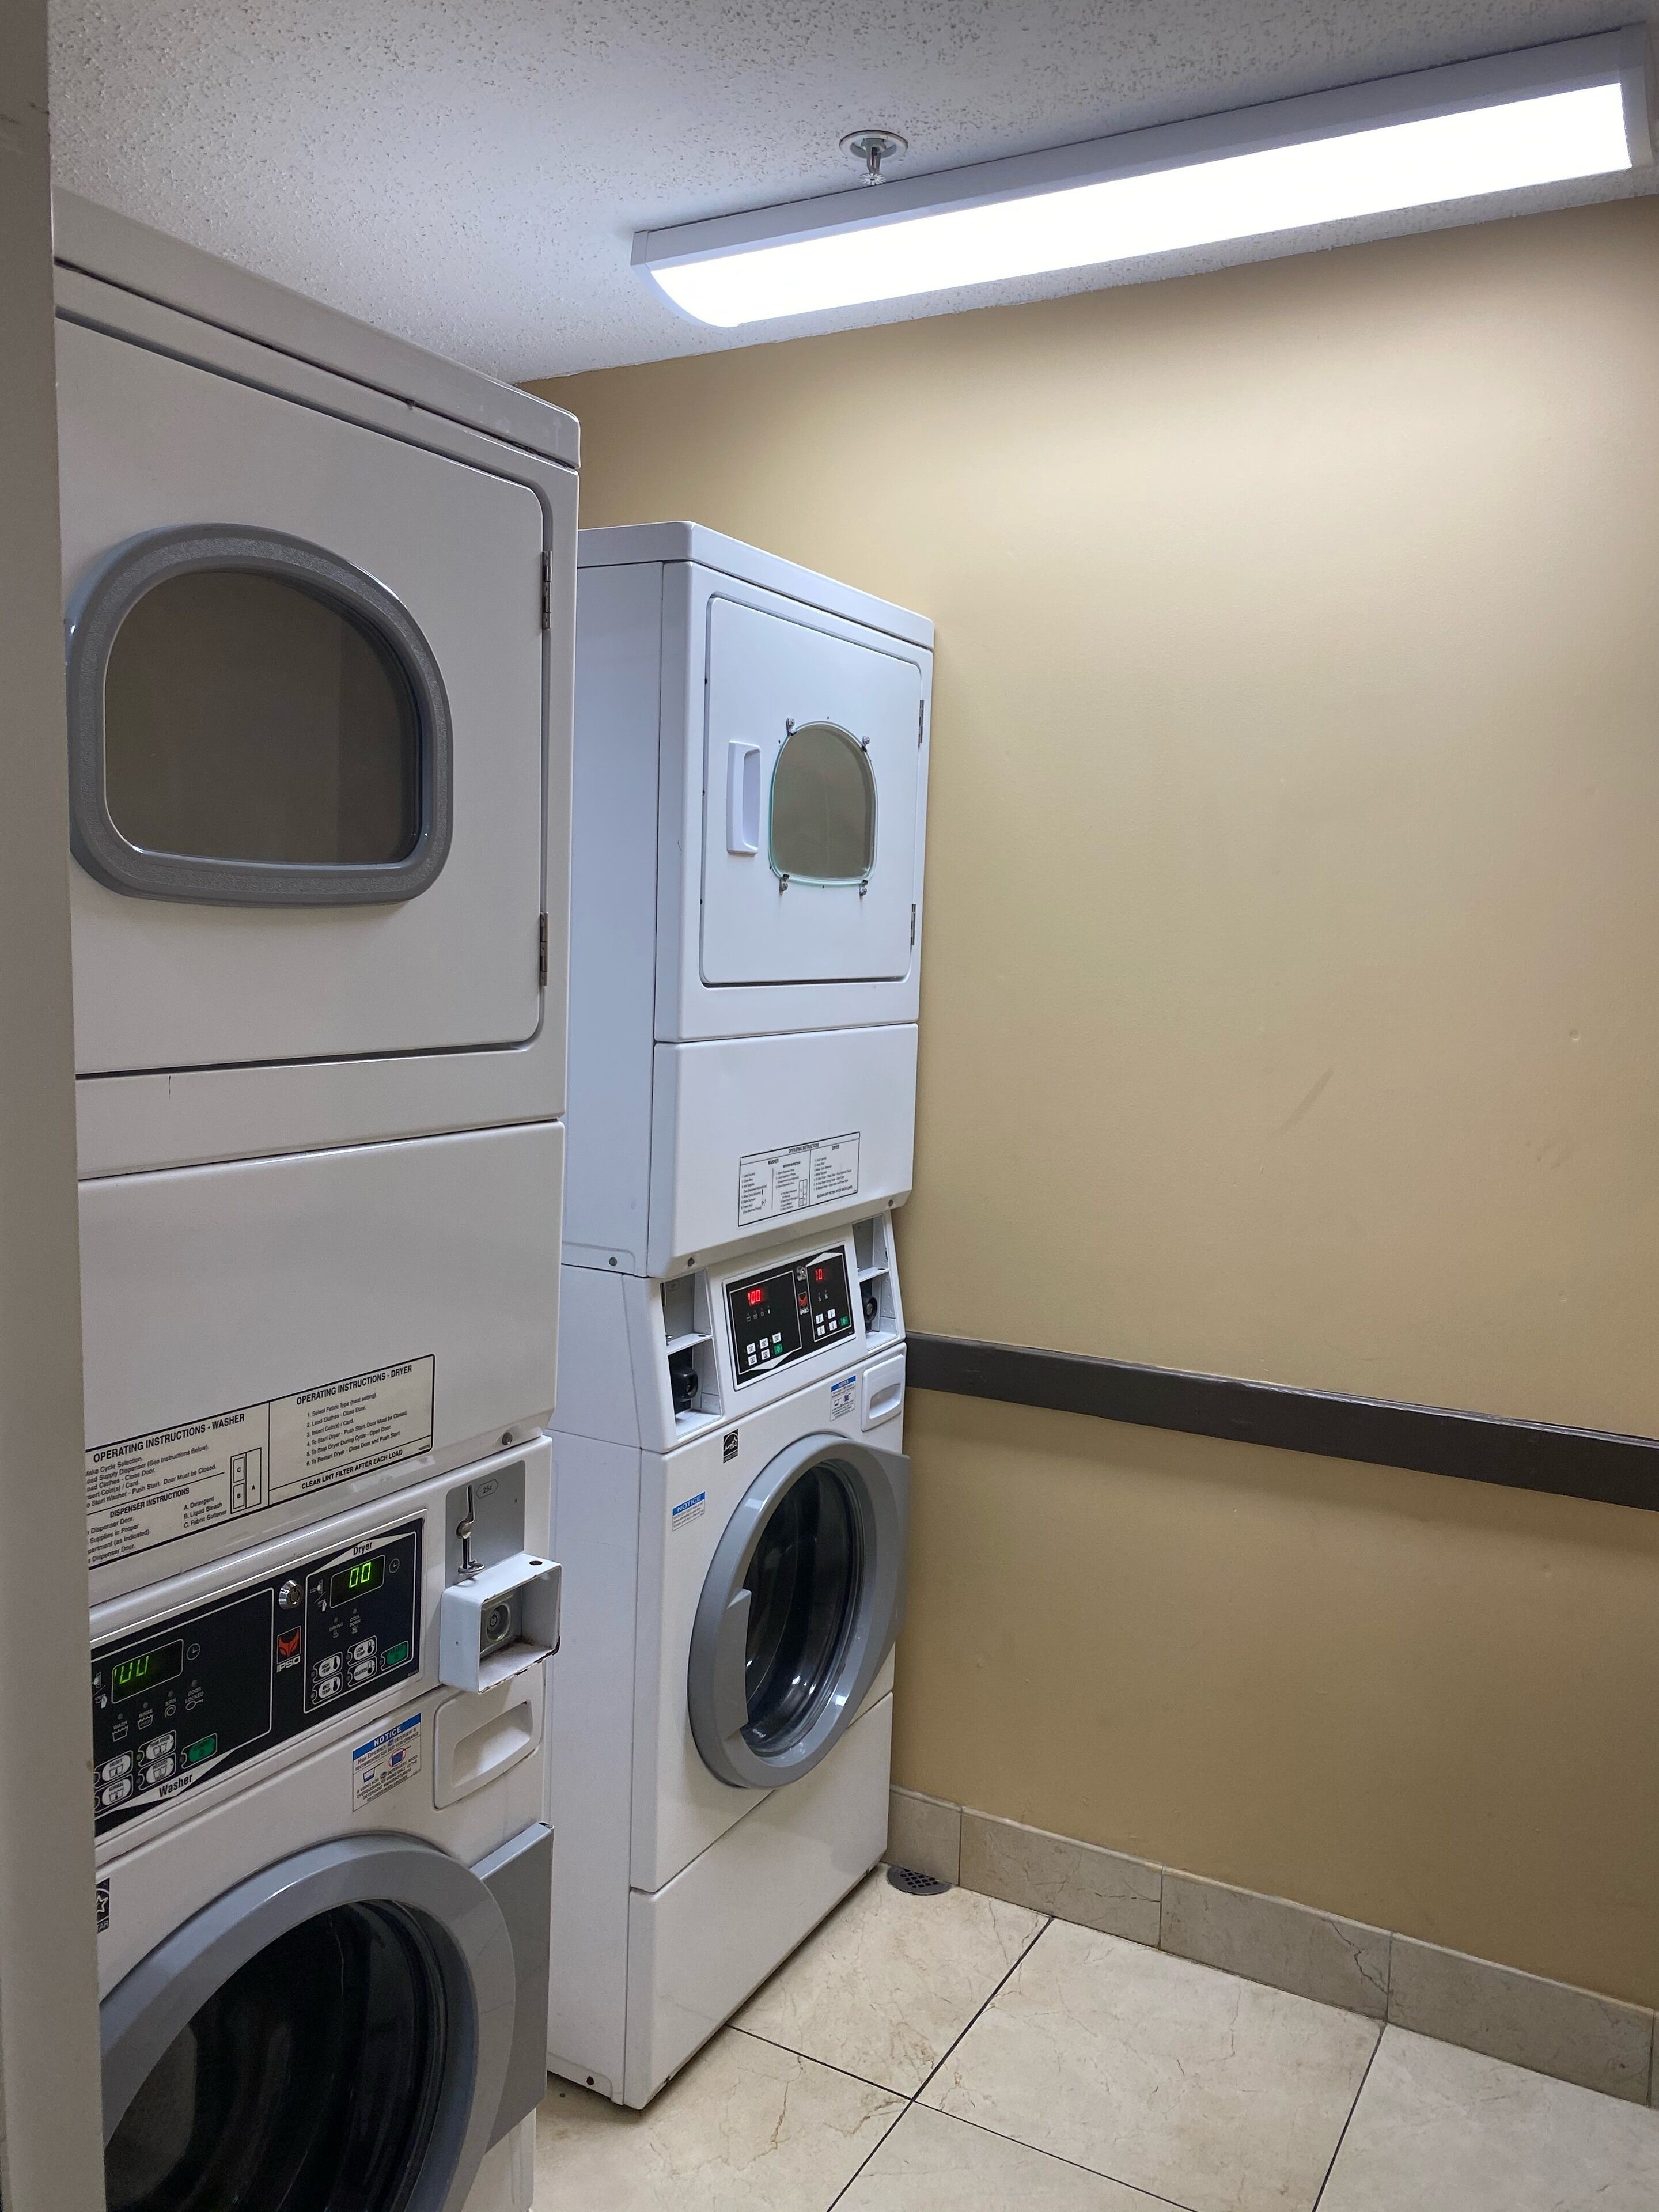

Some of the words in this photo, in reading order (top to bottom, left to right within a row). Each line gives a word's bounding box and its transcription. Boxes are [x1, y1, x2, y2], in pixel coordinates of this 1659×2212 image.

[296, 1387, 336, 1405] OPERATING
[338, 1372, 385, 1393] INSTRUCTIONS
[391, 1365, 412, 1377] DRYER
[312, 1408, 325, 1416] Select
[323, 1414, 339, 1422] Clothes
[93, 1441, 143, 1463] OPERATING
[146, 1424, 205, 1448] INSTRUCTIONS
[211, 1413, 244, 1430] WASHER
[312, 1427, 324, 1435] Insert
[340, 1437, 354, 1445] During
[86, 1476, 97, 1484] oad
[99, 1471, 118, 1480] Supply
[119, 1463, 146, 1475] Dispenser
[147, 1459, 160, 1467] (See
[161, 1450, 190, 1463] Instructions
[191, 1444, 209, 1454] Below).
[100, 1464, 115, 1472] Cycle
[117, 1457, 143, 1468] Selection.
[317, 1453, 332, 1462] Restart
[301, 1478, 320, 1489] CLEAN
[322, 1473, 334, 1482] LINT
[335, 1466, 353, 1478] FILTER
[355, 1460, 372, 1471] AFTER
[373, 1455, 388, 1464] EACH
[388, 1449, 403, 1459] LOAD
[86, 1491, 100, 1499] nsert
[101, 1485, 120, 1495] Coin(s)
[125, 1479, 139, 1488] Card.
[87, 1484, 97, 1492] oad
[99, 1479, 120, 1488] Clothes
[124, 1472, 140, 1480] Close
[92, 1497, 105, 1506] Start
[106, 1492, 127, 1501] Washer
[132, 1486, 145, 1494] Push
[198, 1464, 216, 1474] Closed.
[110, 1501, 145, 1518] DISPENSER
[146, 1487, 189, 1506] INSTRUCTIONS
[190, 1496, 214, 1508] Detergent
[190, 1508, 204, 1517] Liquid
[206, 1502, 222, 1512] Bleach
[677, 1495, 701, 1512] NOTICE
[190, 1517, 205, 1525] Fabric
[206, 1510, 227, 1520] Softener
[90, 1532, 113, 1544] Supplies
[121, 1524, 139, 1533] Proper
[91, 1521, 118, 1533] Dispenser
[92, 1549, 120, 1562] Dispenser
[121, 1544, 135, 1552] Door.
[353, 1541, 373, 1555] Dryer
[349, 1562, 371, 1588] 00
[276, 1656, 301, 1673] IPSO
[185, 1691, 204, 1703] LOCKED
[188, 1687, 202, 1696] DOOR
[374, 1726, 402, 1747] NOTICE
[159, 1774, 193, 1797] Washer
